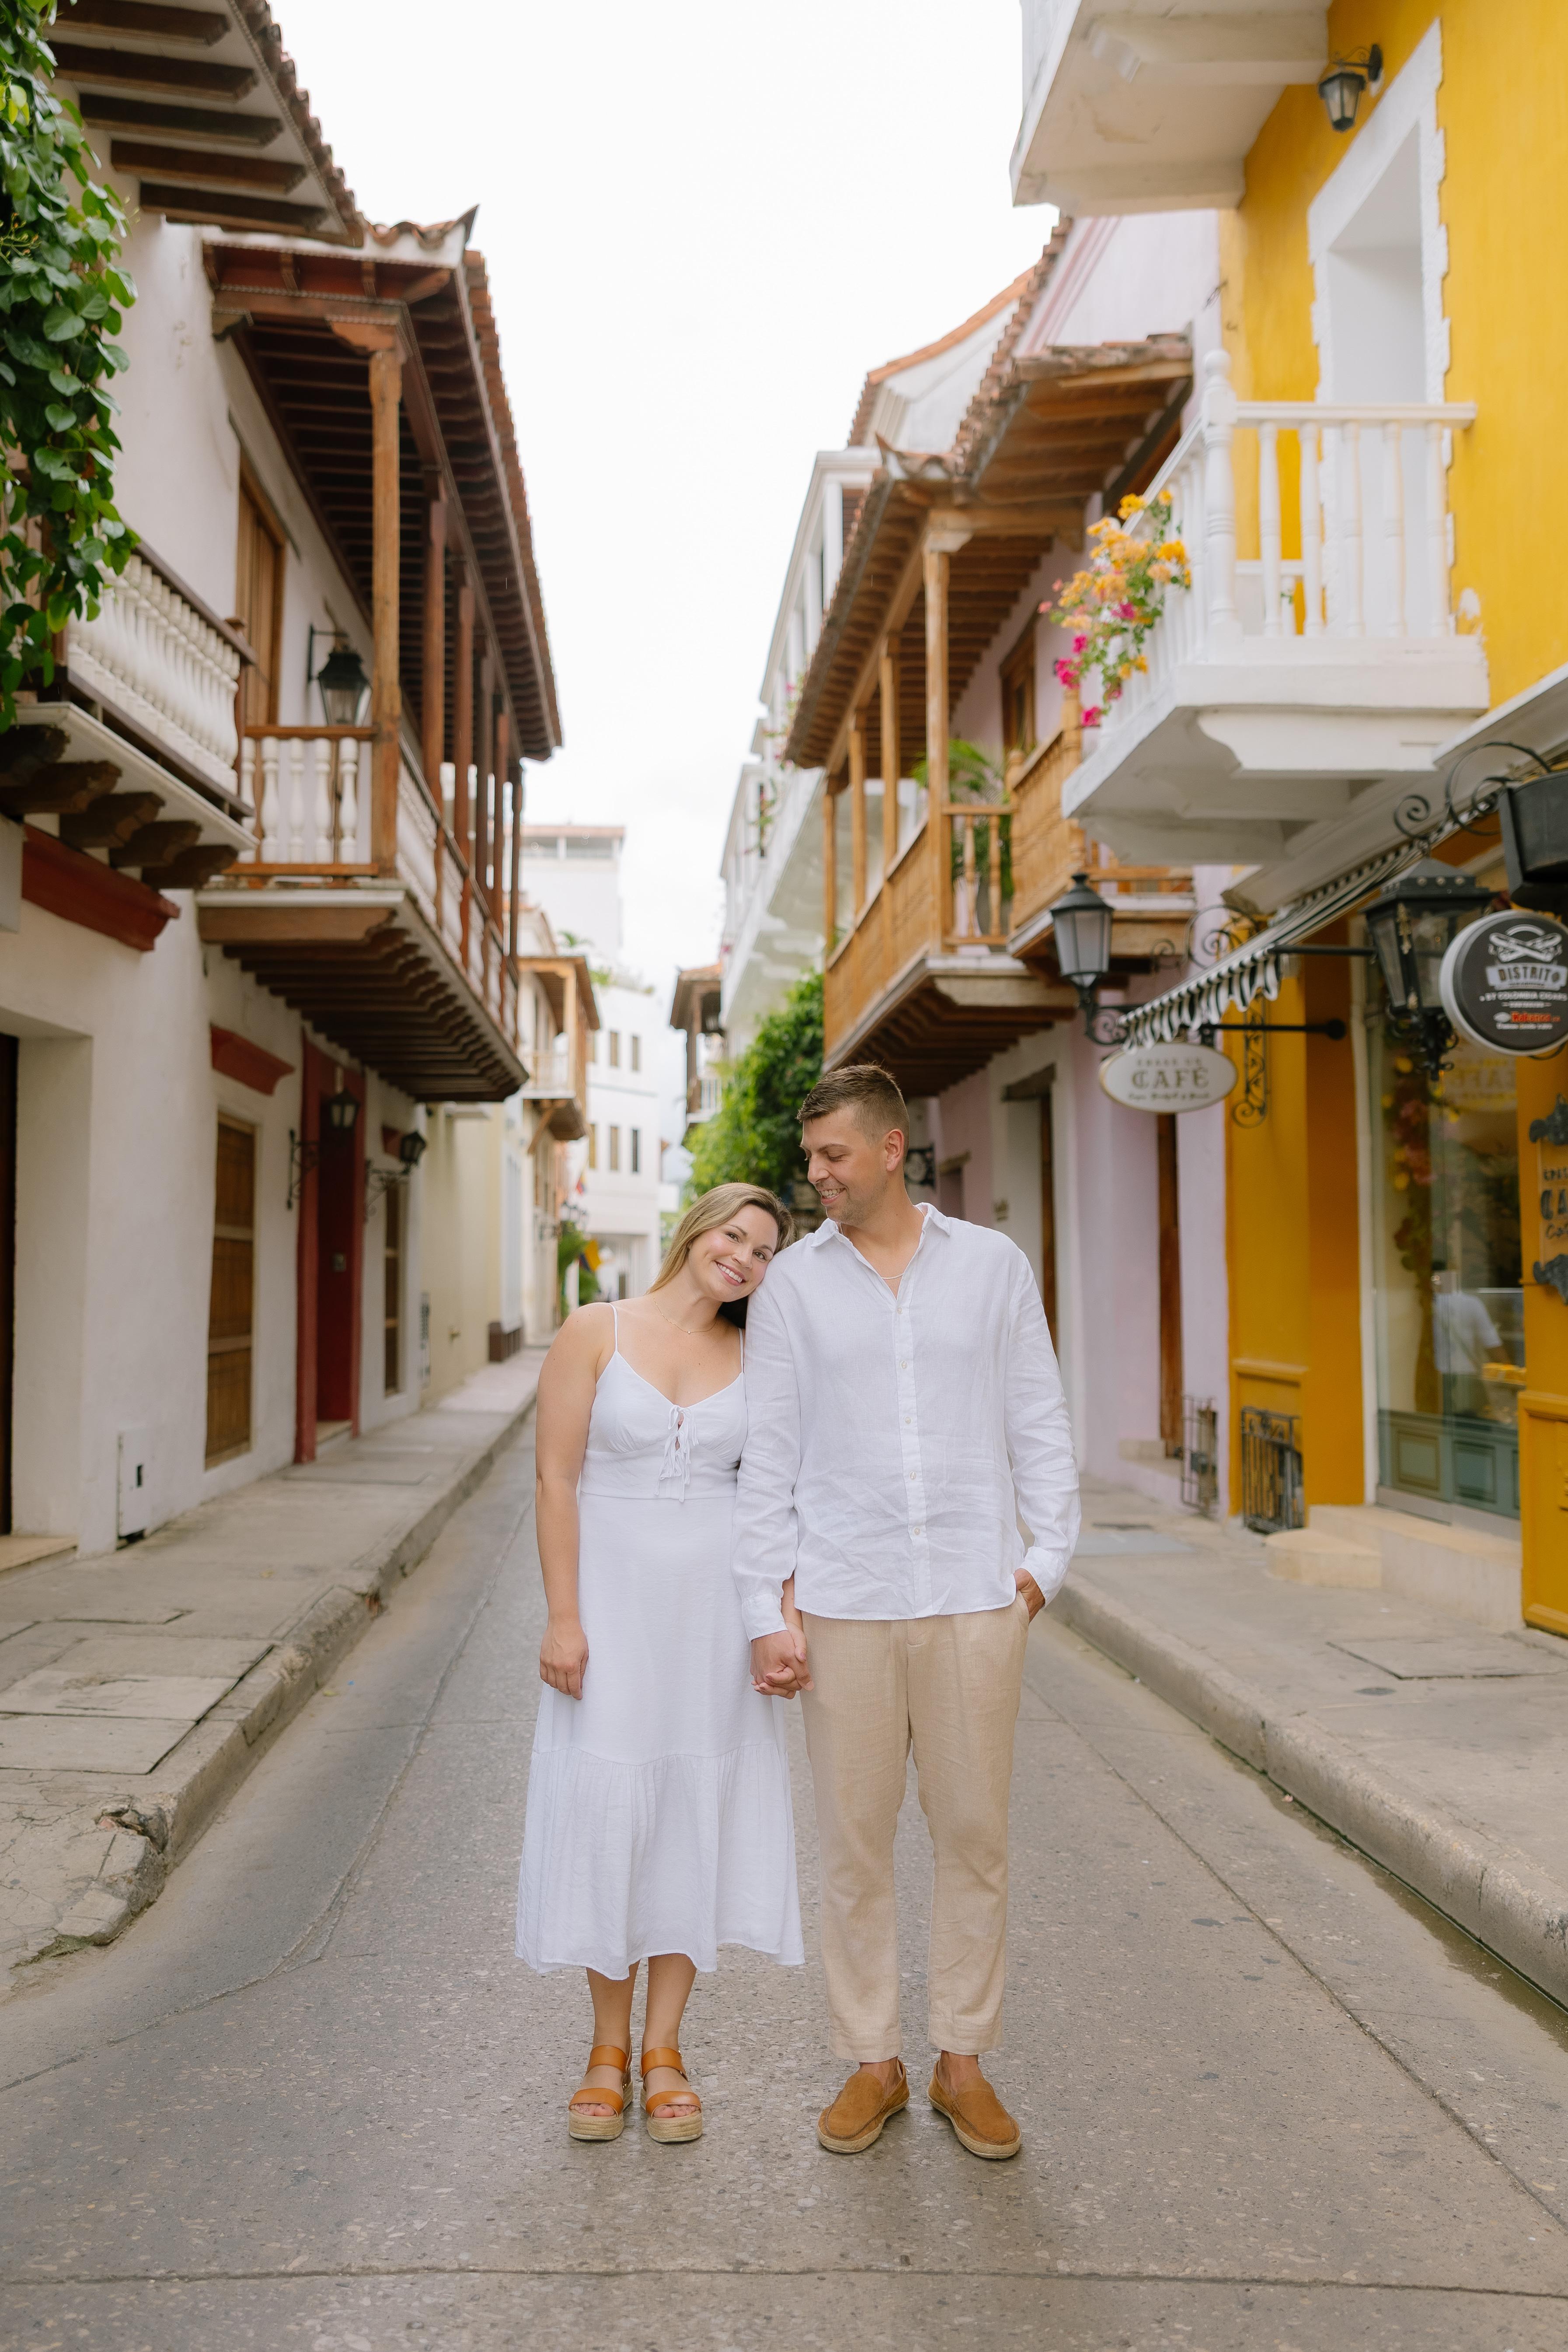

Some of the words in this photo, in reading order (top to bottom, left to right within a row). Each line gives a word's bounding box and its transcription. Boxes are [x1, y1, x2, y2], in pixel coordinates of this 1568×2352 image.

[1498, 967, 1560, 982] DISTRITO
[1485, 993, 1496, 1001] BY
[1497, 991, 1538, 1000] COLOMBIA
[1539, 992, 1568, 1001] CIGARS
[1132, 1066, 1209, 1089] CAFÉ
